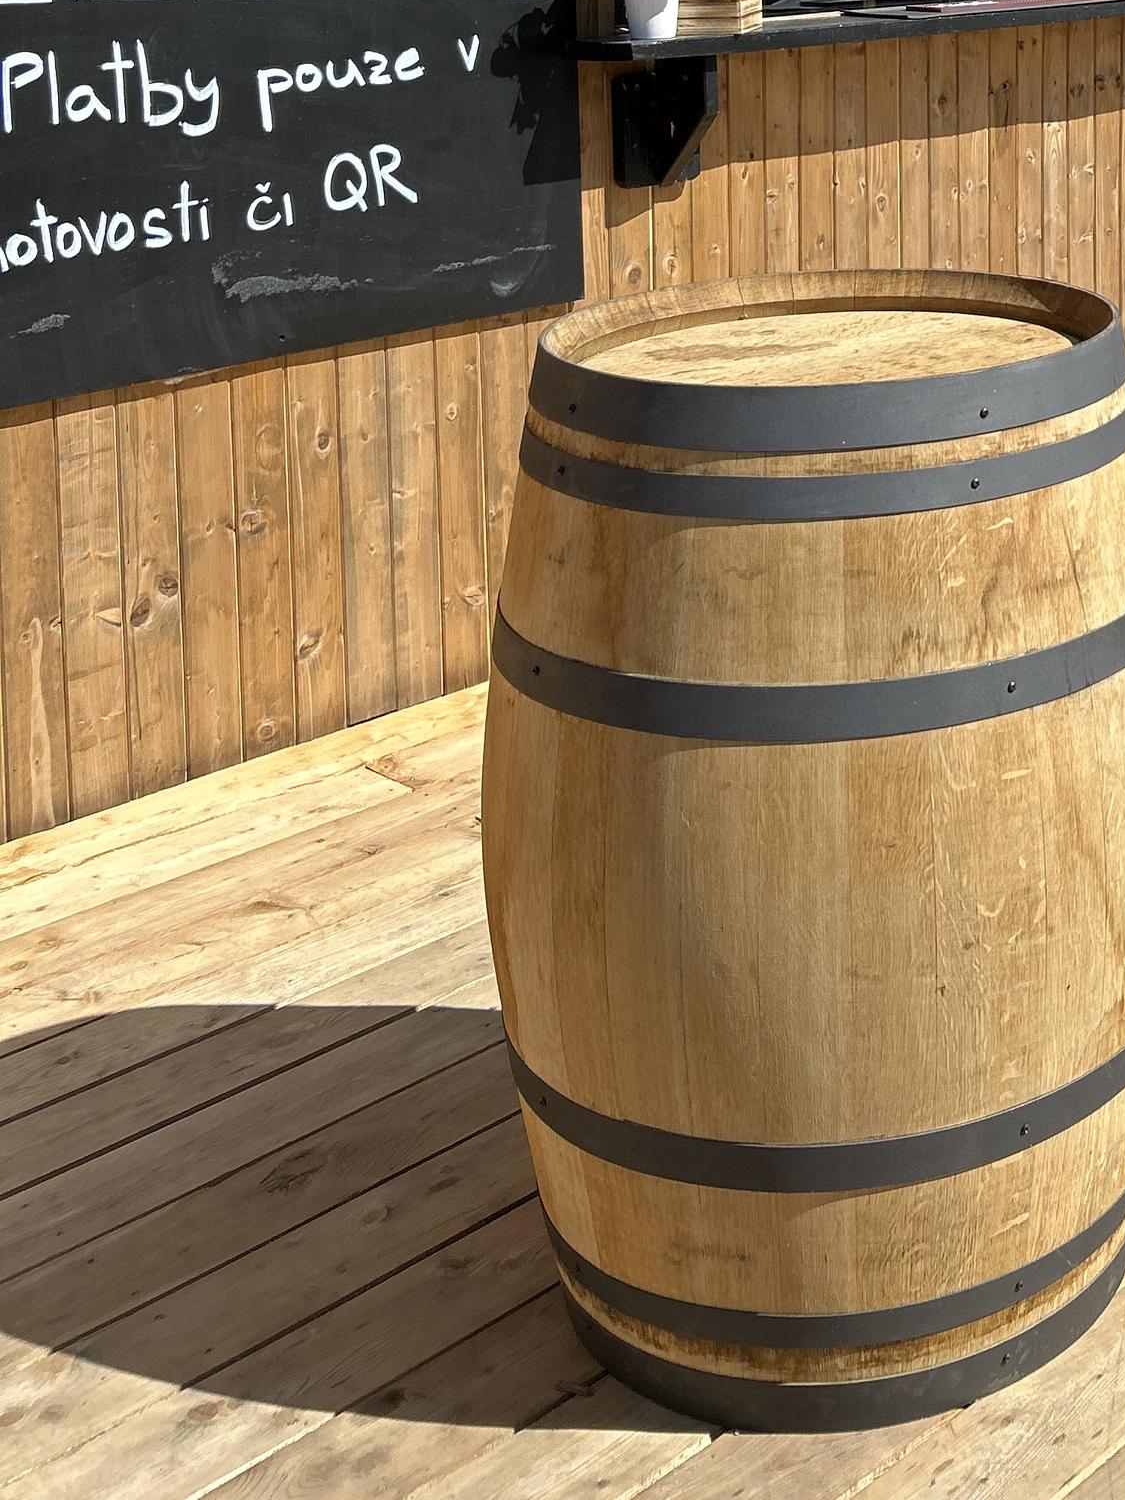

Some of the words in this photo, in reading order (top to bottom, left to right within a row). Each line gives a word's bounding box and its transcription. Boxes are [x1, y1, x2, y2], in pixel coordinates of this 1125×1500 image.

[2, 38, 220, 136] Platby
[257, 47, 426, 132] pouze
[323, 143, 418, 213] QR
